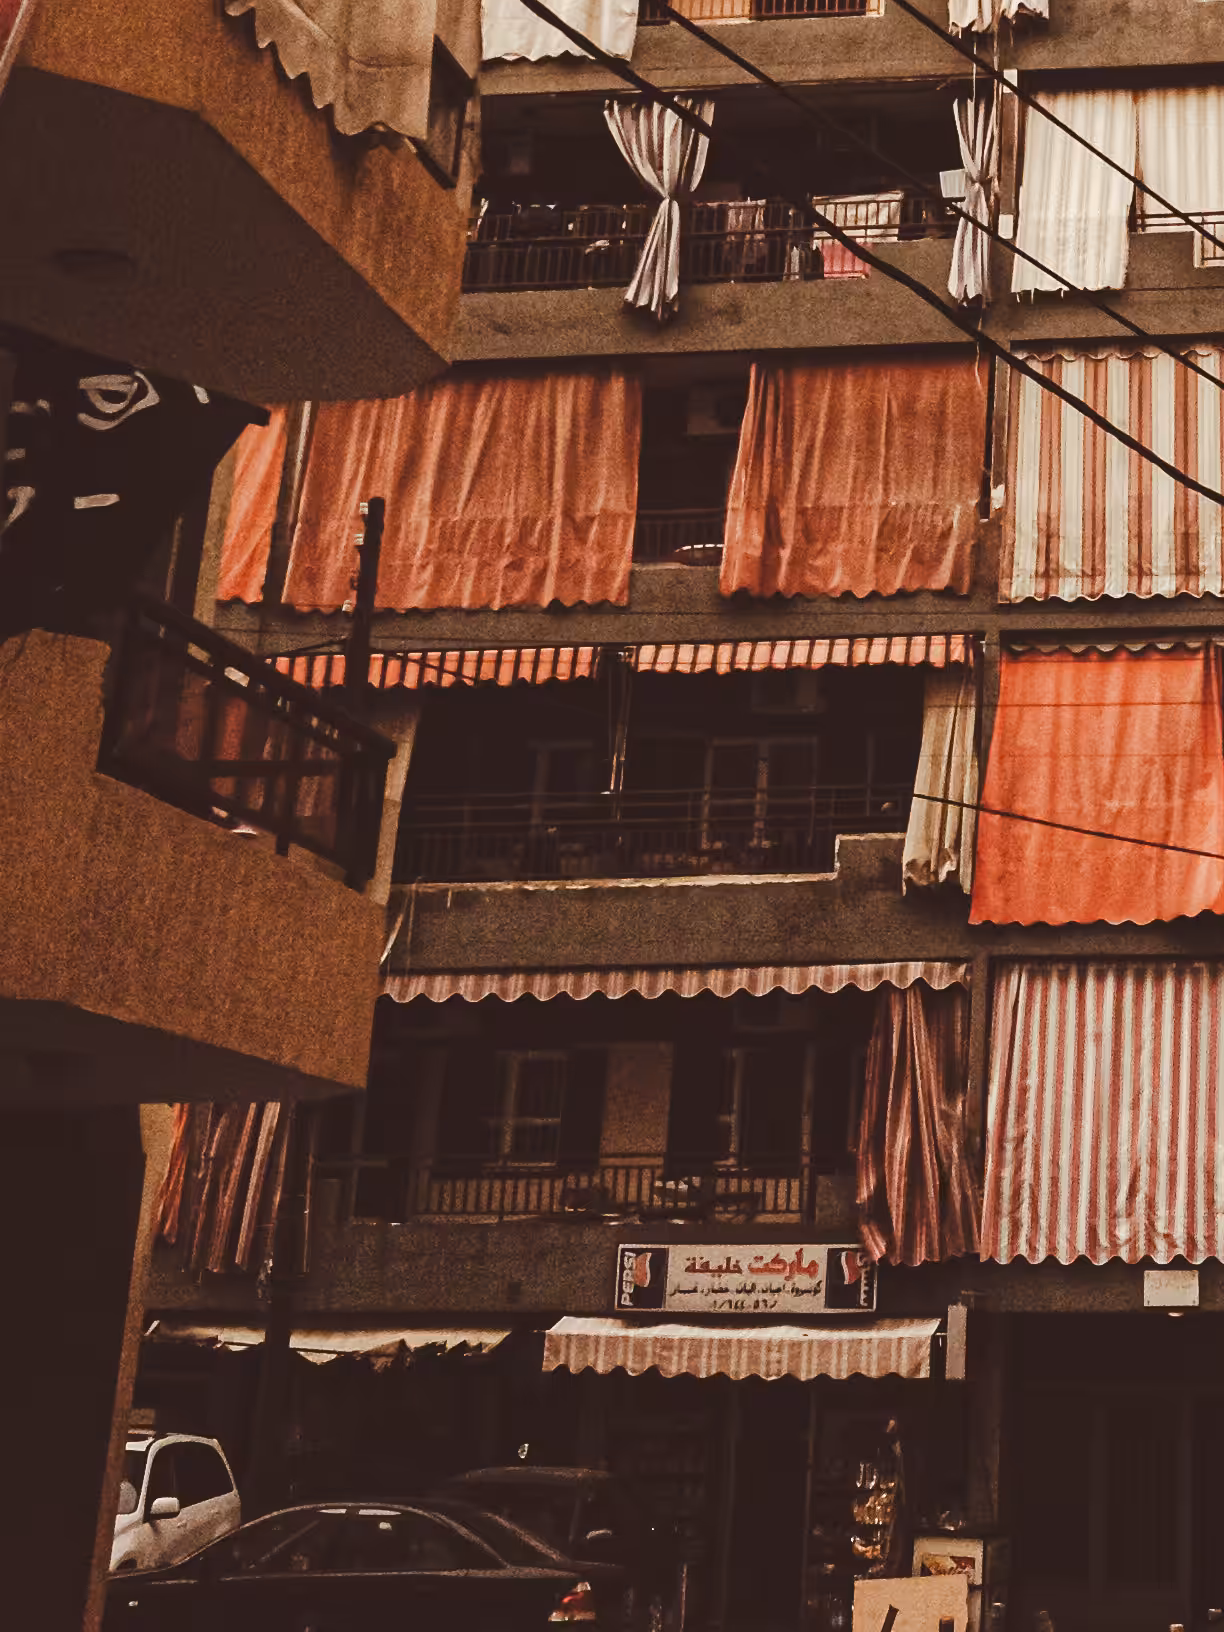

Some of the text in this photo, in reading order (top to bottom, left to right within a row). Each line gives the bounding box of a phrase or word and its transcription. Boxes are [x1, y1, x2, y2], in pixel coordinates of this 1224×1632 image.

[621, 1251, 637, 1306] PEPSI
[684, 1248, 820, 1281] ماركت خليفة
